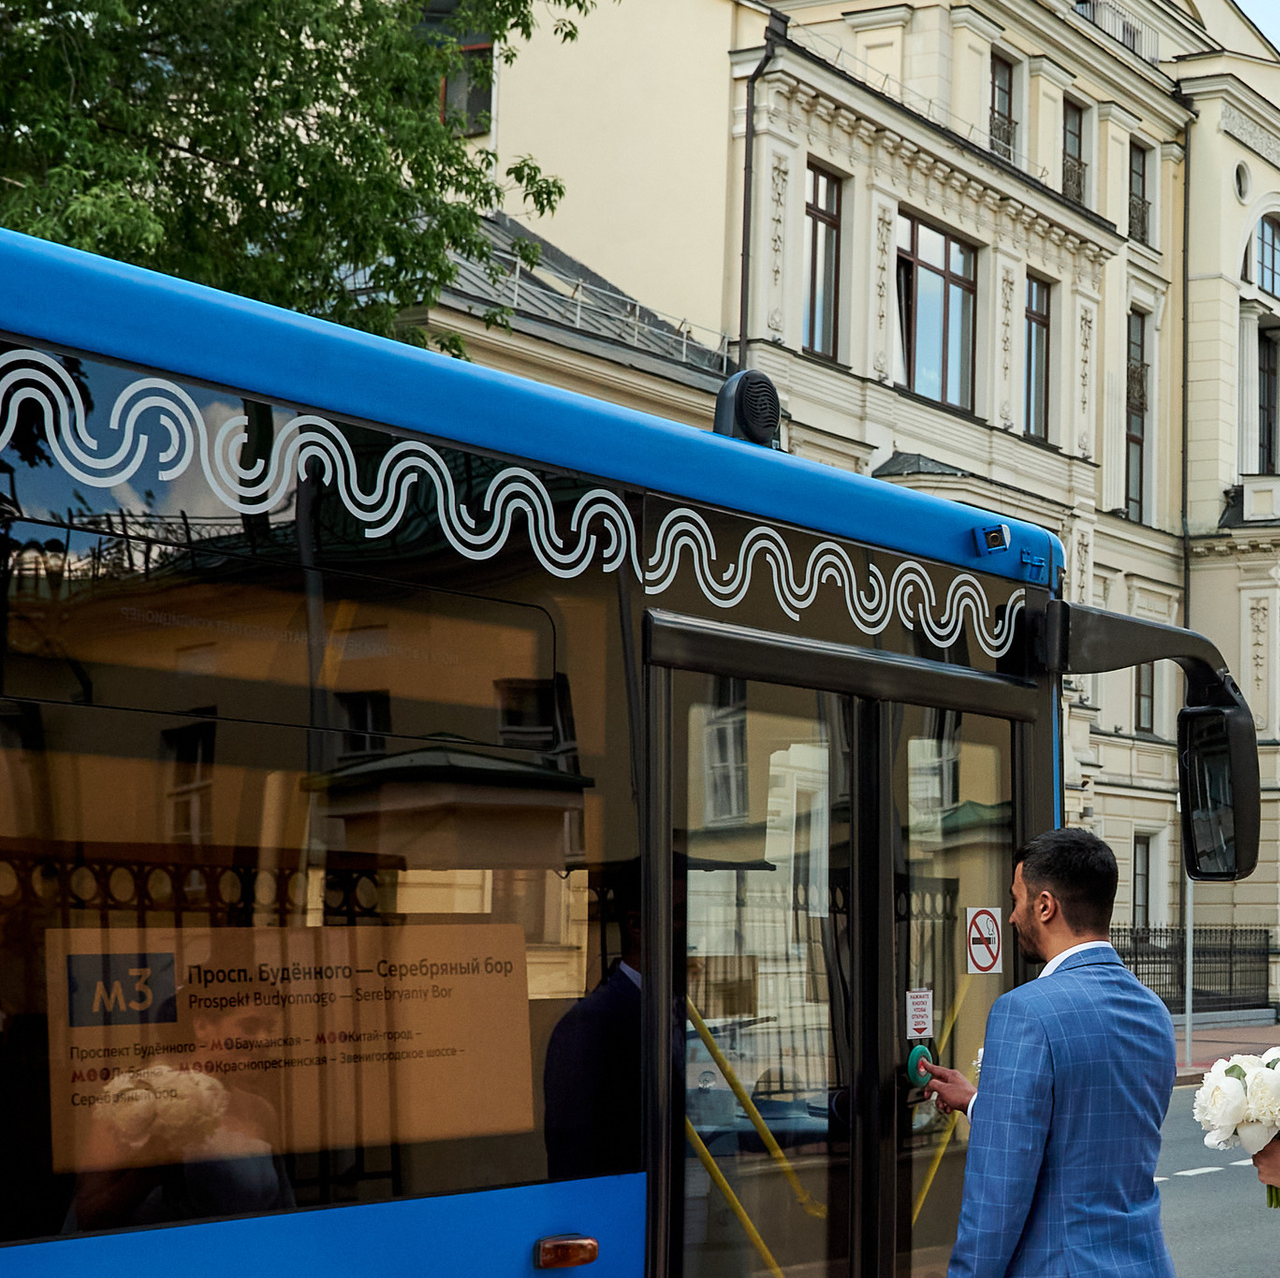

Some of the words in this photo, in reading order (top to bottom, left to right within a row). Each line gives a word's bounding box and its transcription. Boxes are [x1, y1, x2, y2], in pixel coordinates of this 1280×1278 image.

[187, 964, 253, 988] Просп.
[258, 962, 352, 986] Будённого
[376, 958, 480, 982] Серебряный
[483, 956, 514, 978] бор
[188, 991, 250, 1012] Prospekt
[253, 989, 337, 1008] Budyonnogo
[355, 985, 430, 1003] Serebryaniy
[431, 984, 453, 998] Bor
[69, 1045, 131, 1062] Проспект
[133, 1041, 196, 1059] Будённого
[234, 1036, 301, 1052] Бауманская
[347, 1029, 413, 1045] Китай-город
[215, 1054, 328, 1074] Краснопресненская
[339, 1048, 424, 1065] Звенигородское
[426, 1047, 457, 1058] шоссе
